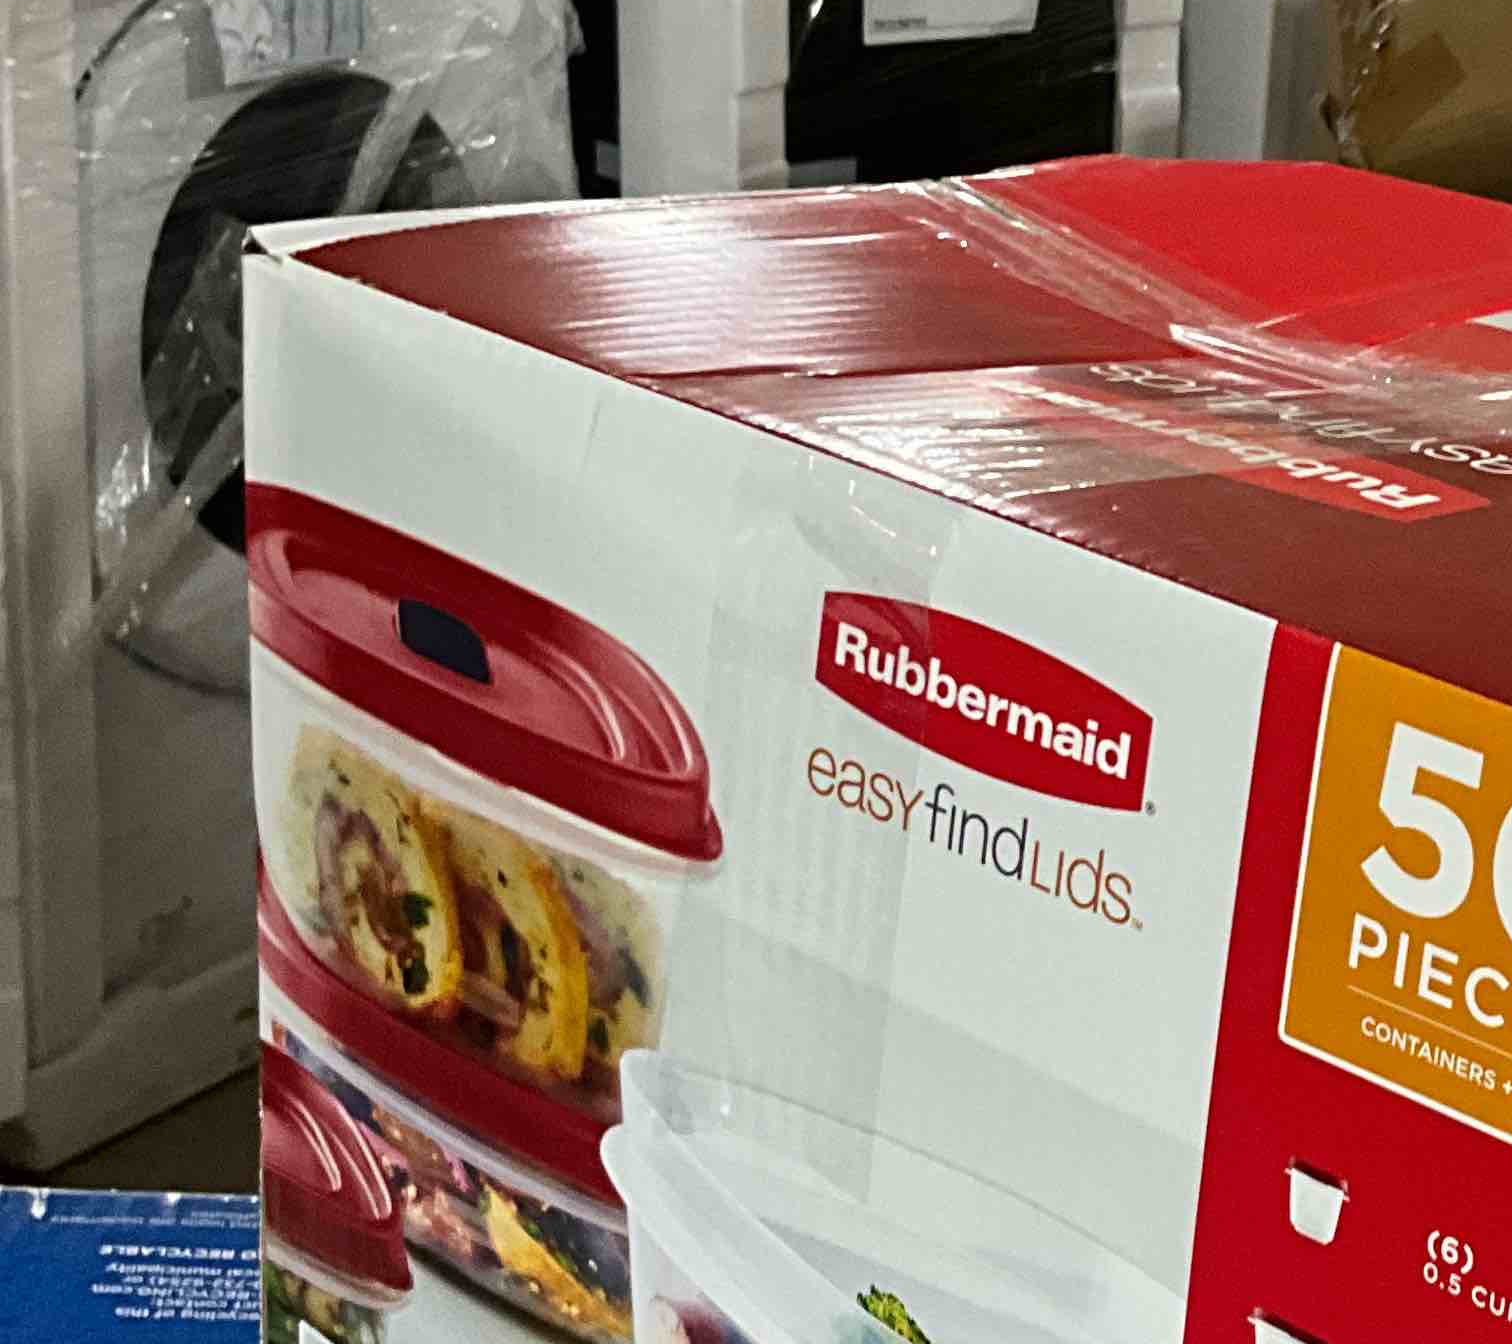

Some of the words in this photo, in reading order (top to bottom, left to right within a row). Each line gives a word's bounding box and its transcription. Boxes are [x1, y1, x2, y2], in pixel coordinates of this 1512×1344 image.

[834, 621, 1131, 780] Rubbermaid
[807, 746, 1133, 926] easyfindLids
[1360, 1014, 1497, 1092] CONTAINERS
[1422, 1261, 1462, 1297] 0.5
[1426, 1230, 1475, 1275] (6)
